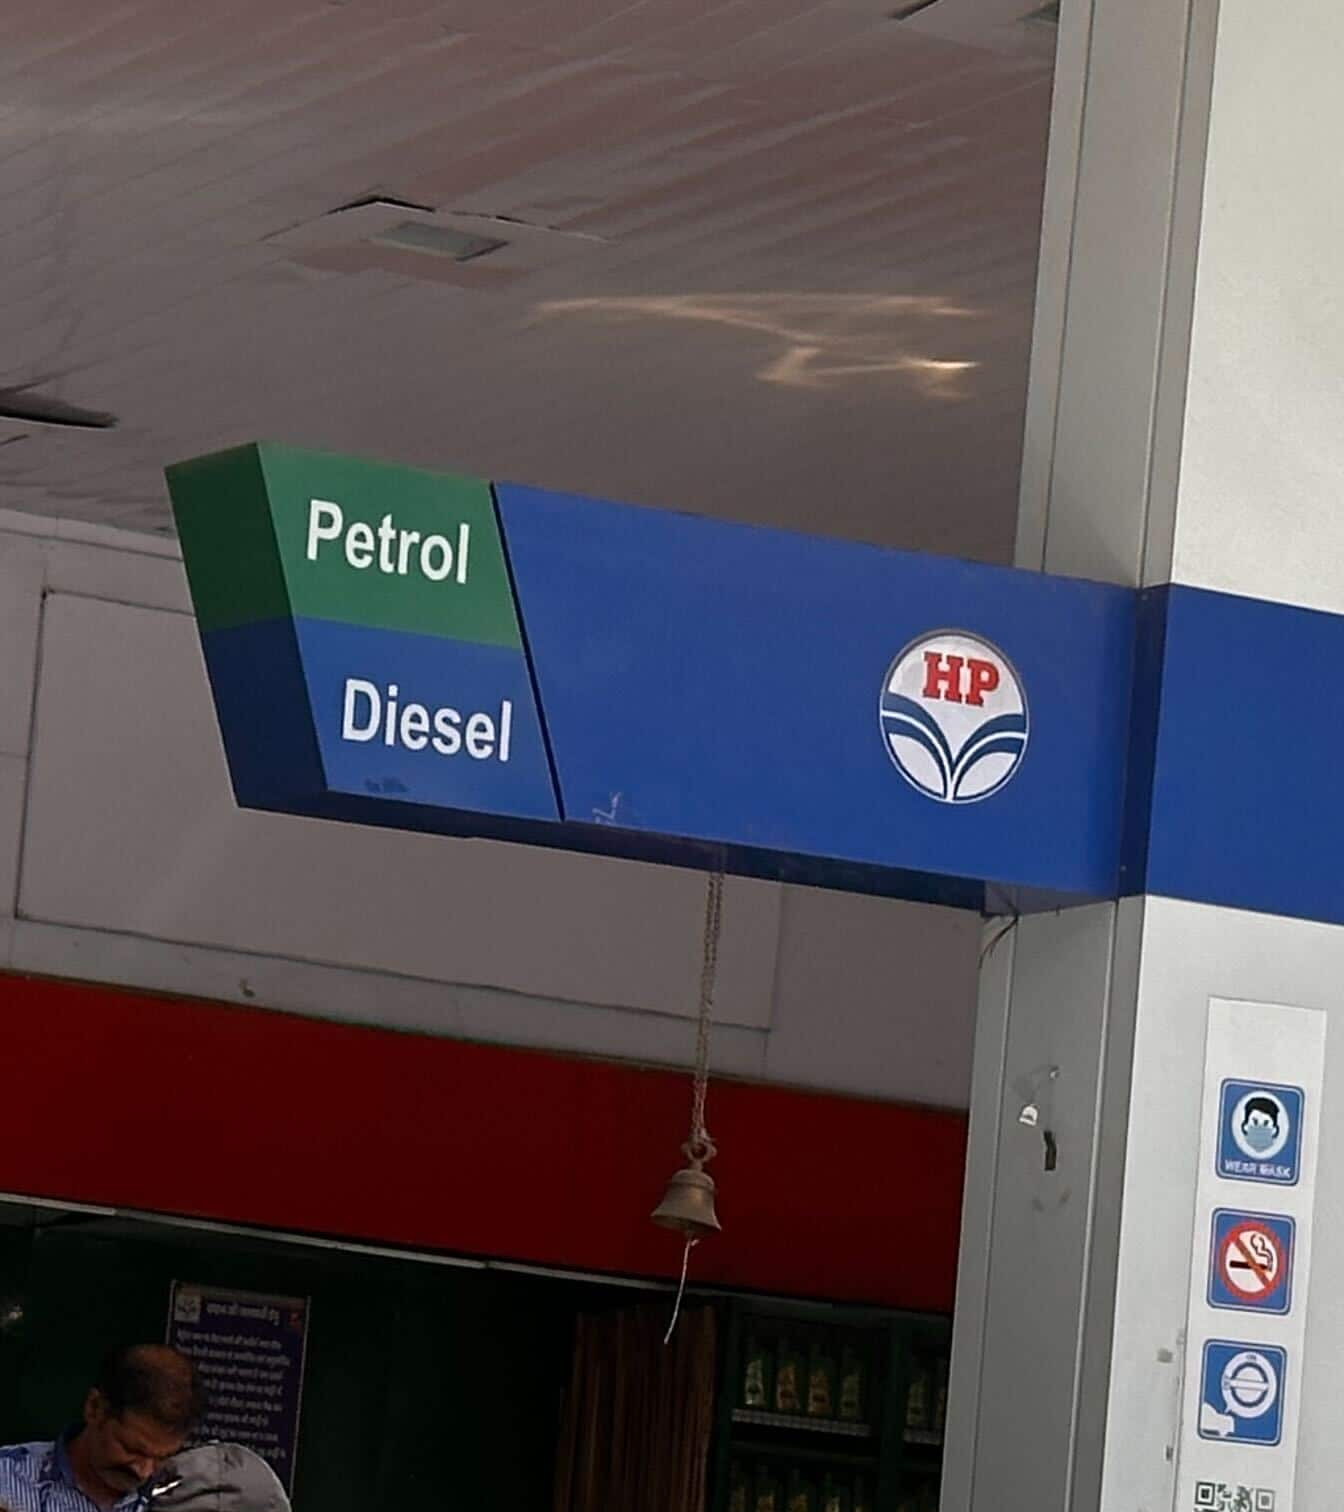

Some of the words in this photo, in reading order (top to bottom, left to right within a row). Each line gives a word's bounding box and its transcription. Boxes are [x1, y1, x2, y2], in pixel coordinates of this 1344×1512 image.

[307, 499, 470, 584] Petrol
[342, 678, 512, 762] Diesel
[922, 650, 1000, 708] HP
